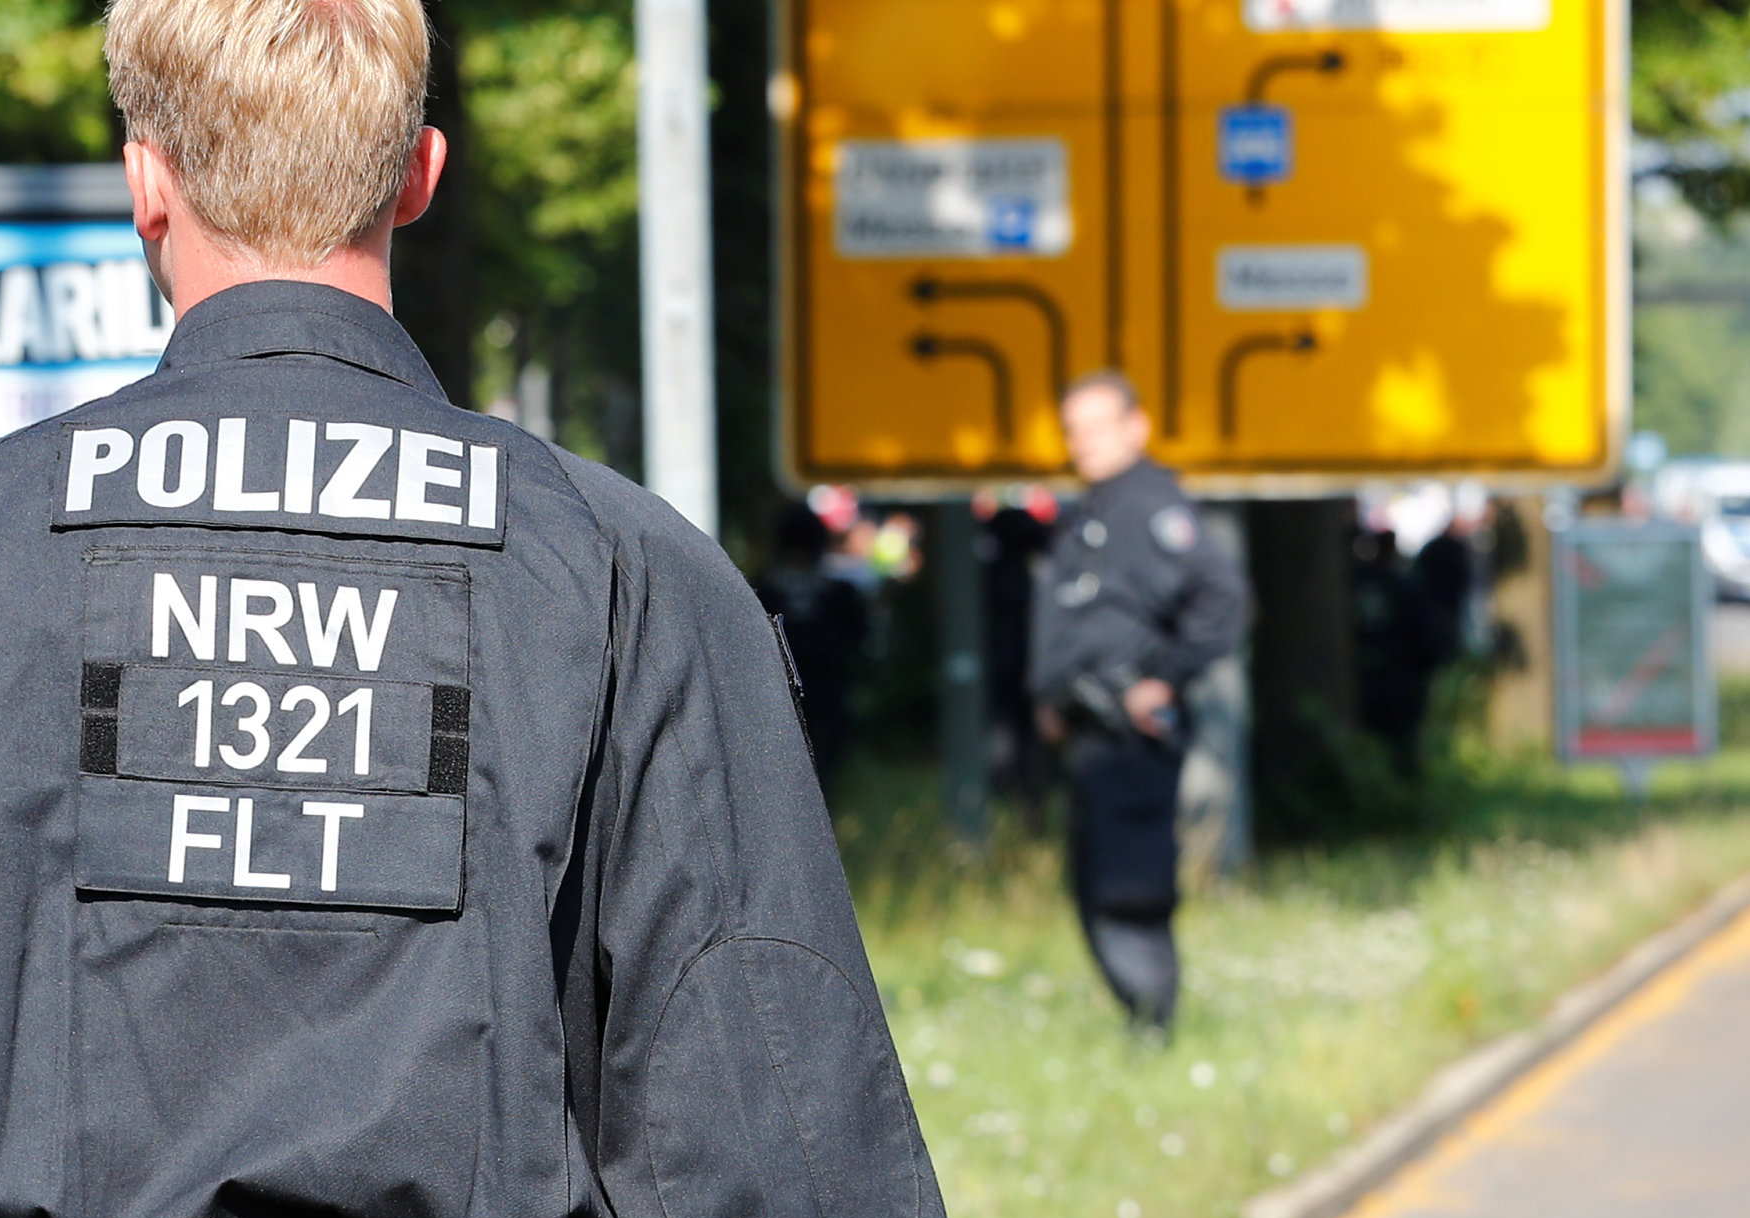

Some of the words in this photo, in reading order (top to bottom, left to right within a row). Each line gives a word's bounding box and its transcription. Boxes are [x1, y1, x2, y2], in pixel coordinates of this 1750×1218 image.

[65, 417, 499, 530] POLIZEI
[151, 572, 399, 672] NRW
[177, 679, 374, 776] 1321
[167, 793, 365, 892] FLT
